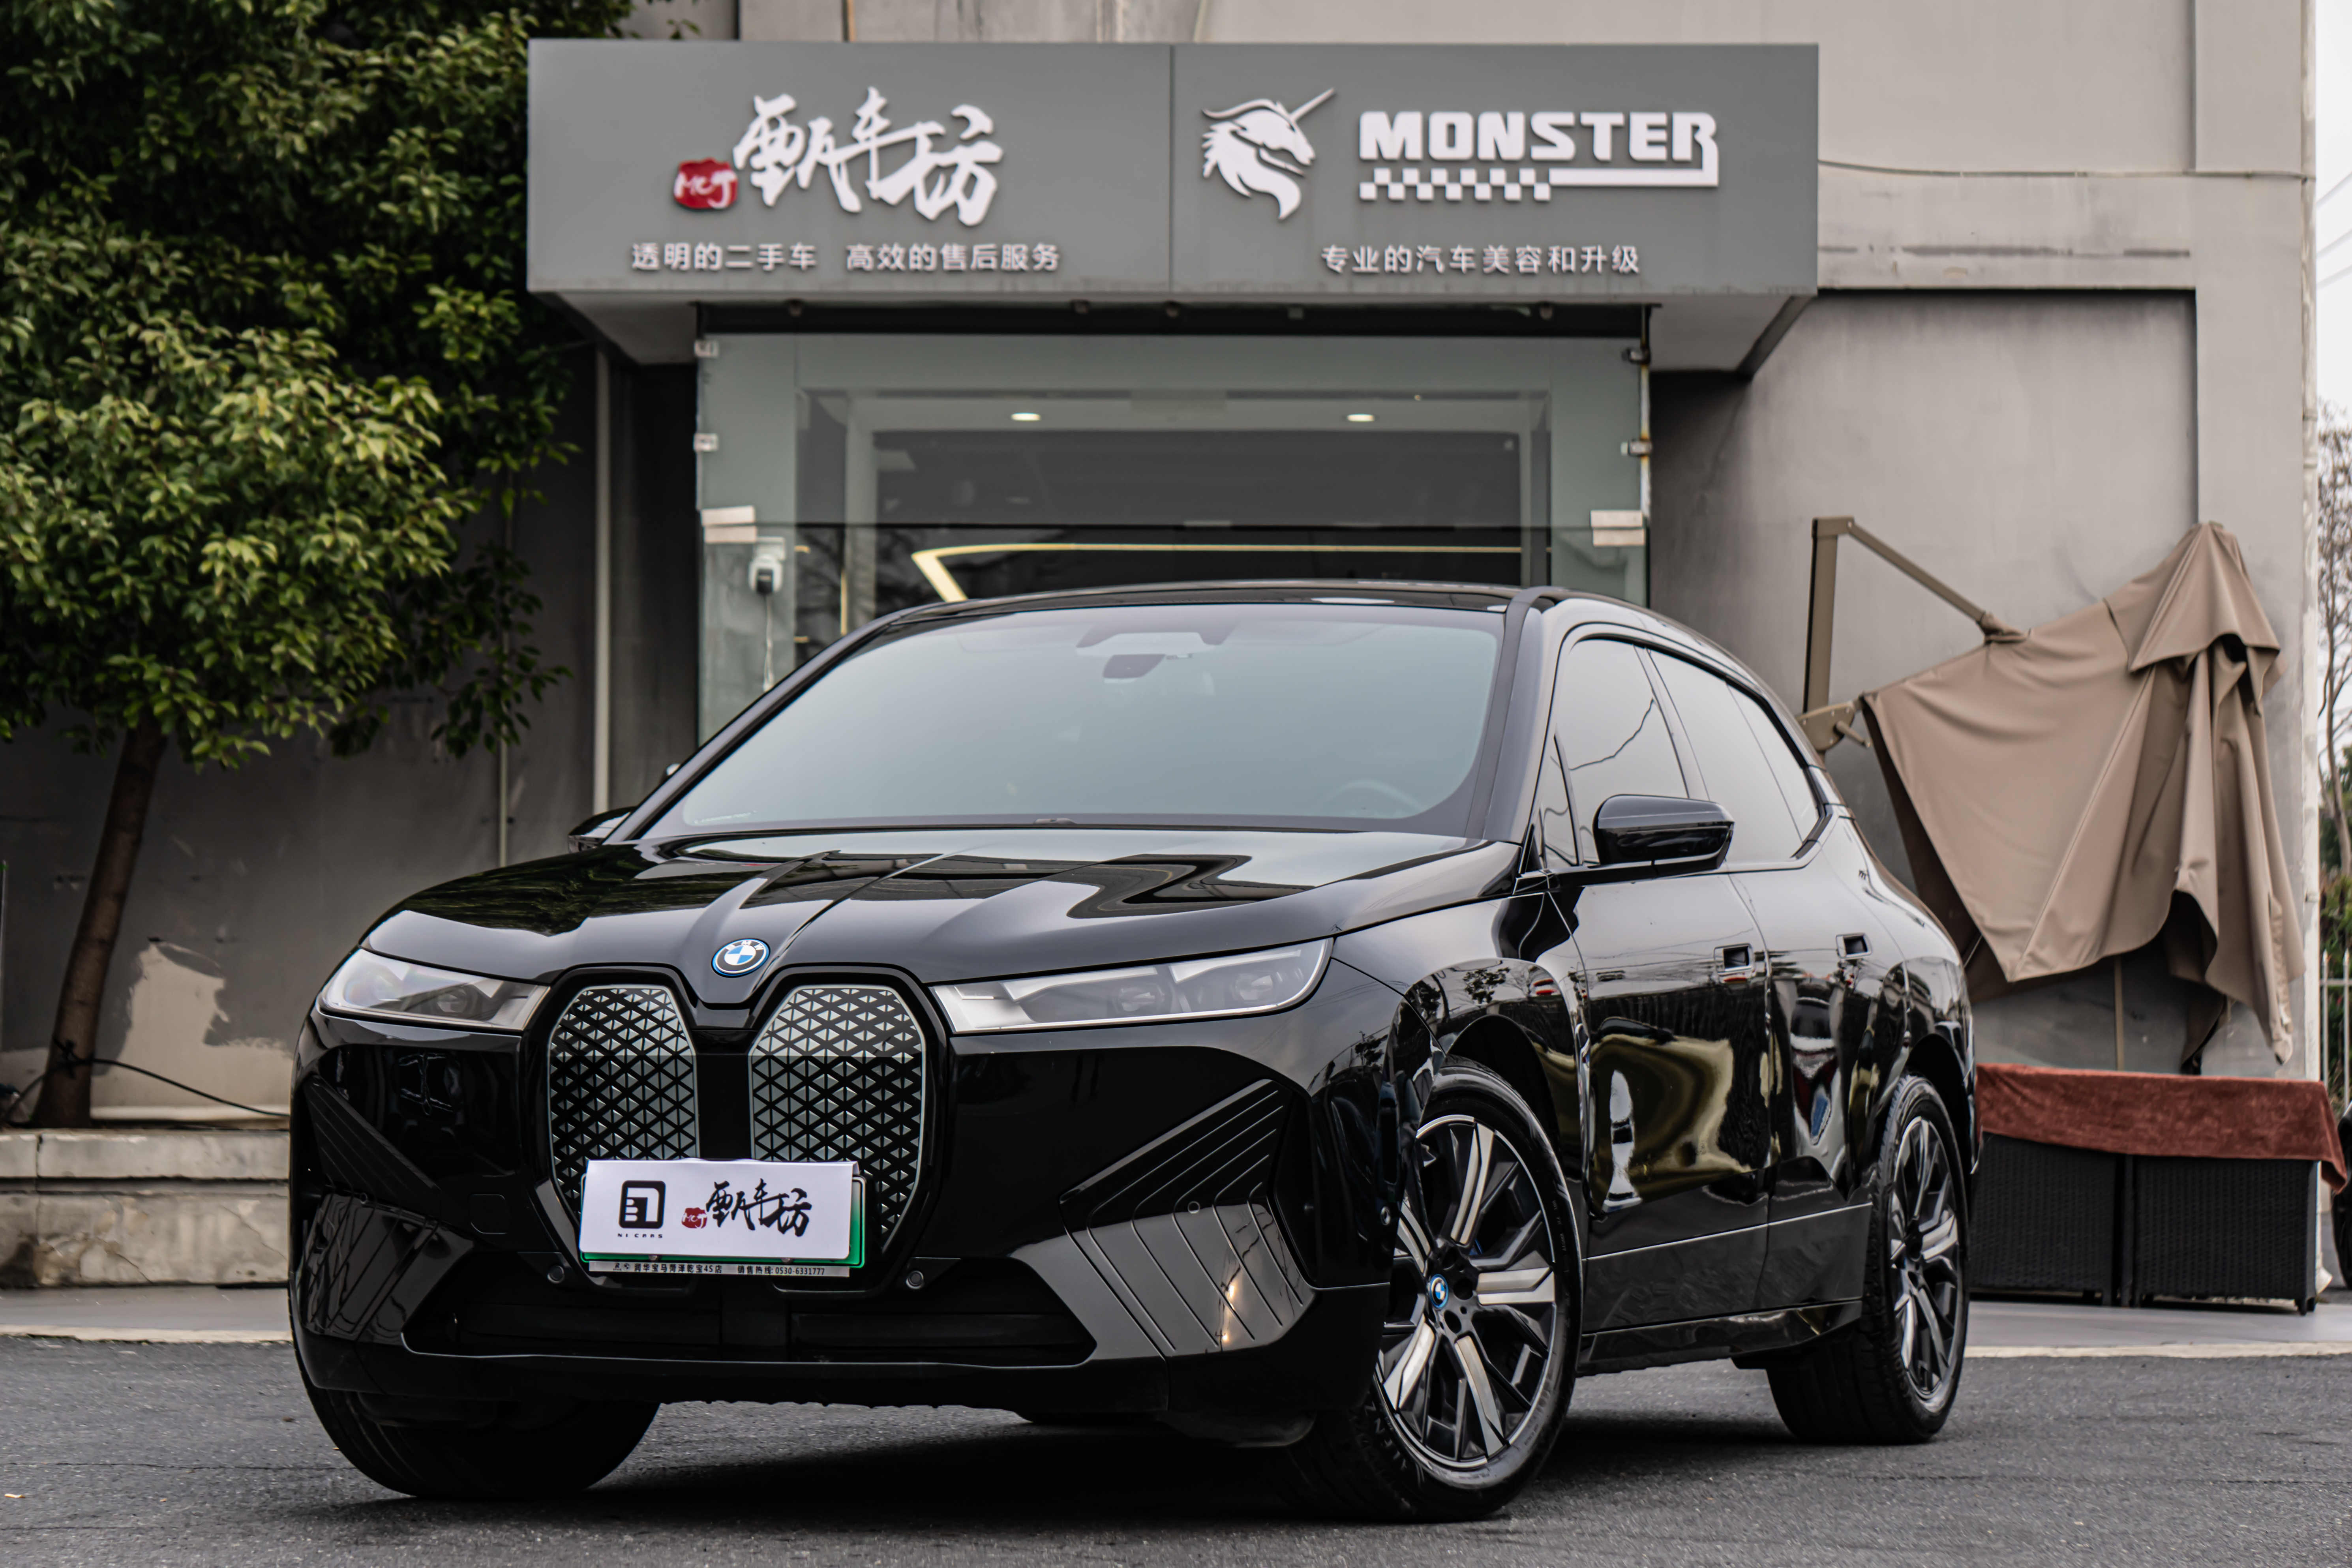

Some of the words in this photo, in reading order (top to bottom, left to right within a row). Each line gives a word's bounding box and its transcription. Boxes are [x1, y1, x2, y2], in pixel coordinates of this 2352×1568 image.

[1360, 111, 1718, 166] MONSTER
[631, 242, 818, 271] 透明的二手车
[846, 242, 1060, 272] 高效的售后服务
[1322, 244, 1640, 274] 专业的汽车美容和升级
